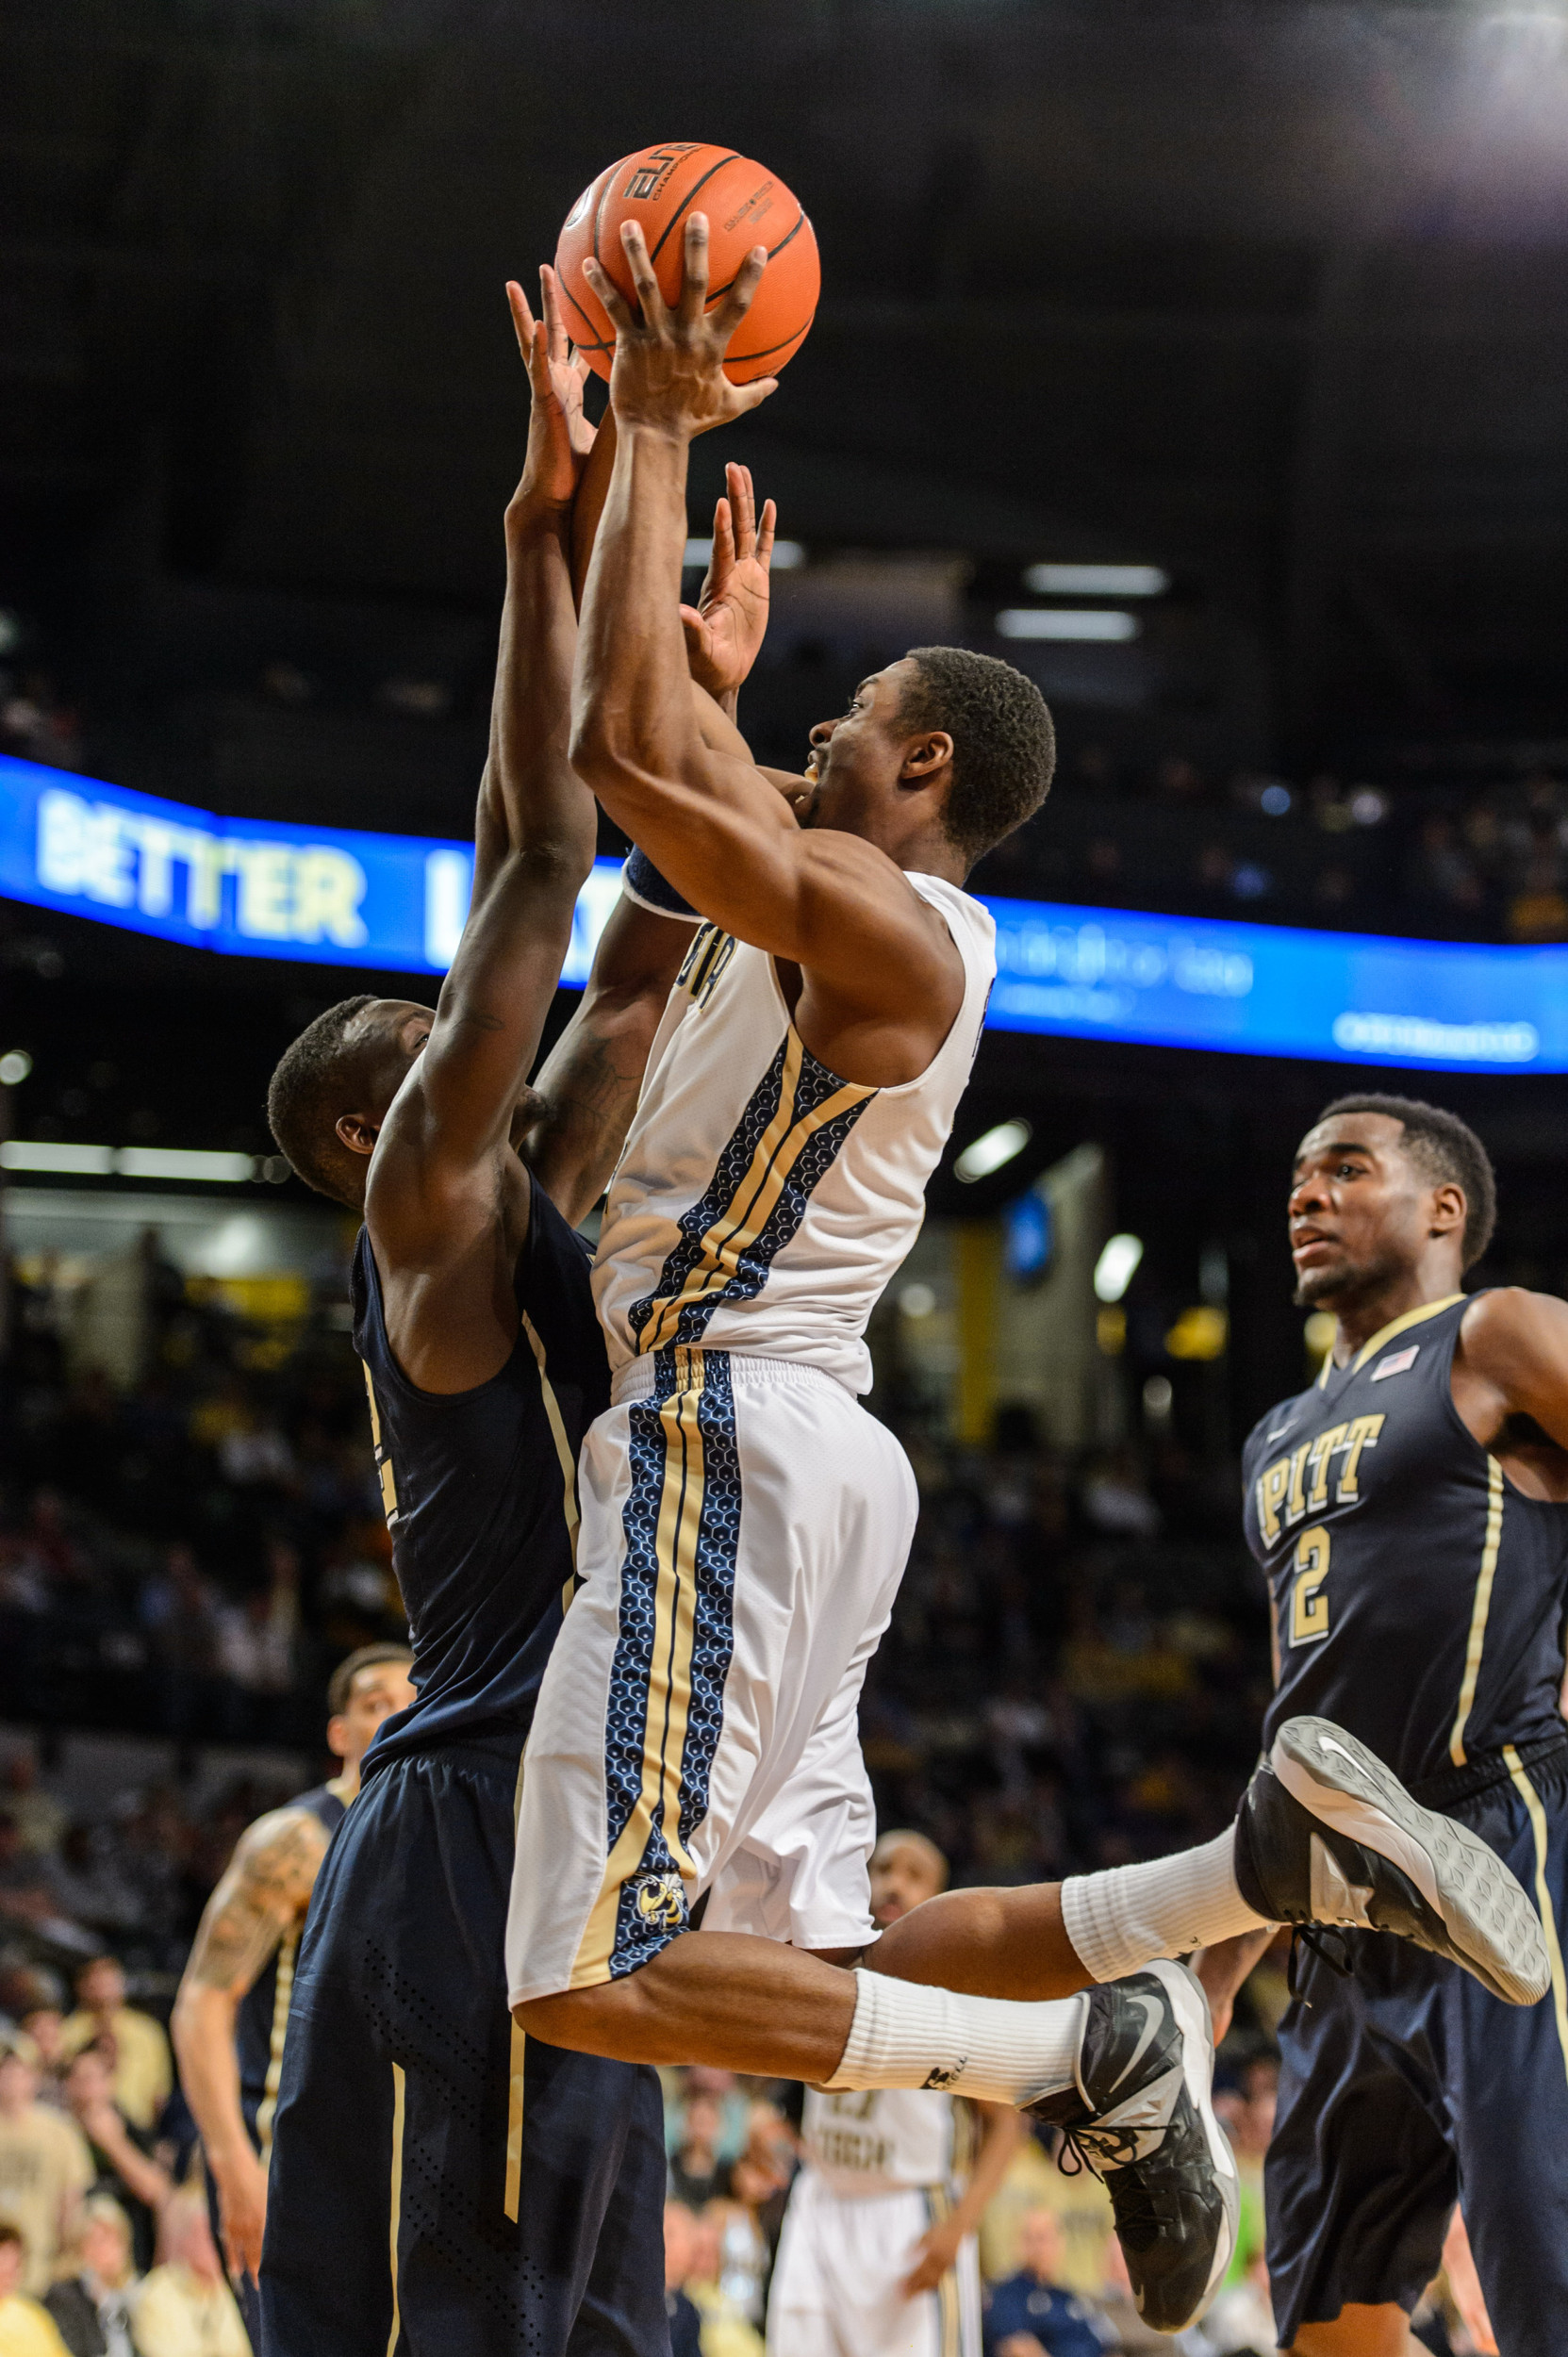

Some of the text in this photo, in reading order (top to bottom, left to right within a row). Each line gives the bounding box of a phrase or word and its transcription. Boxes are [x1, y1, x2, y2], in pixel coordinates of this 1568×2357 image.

[623, 144, 701, 199] ELITE
[36, 786, 371, 948] BETTER
[1256, 1413, 1386, 1550] PITT
[1289, 1525, 1330, 1648] 2
